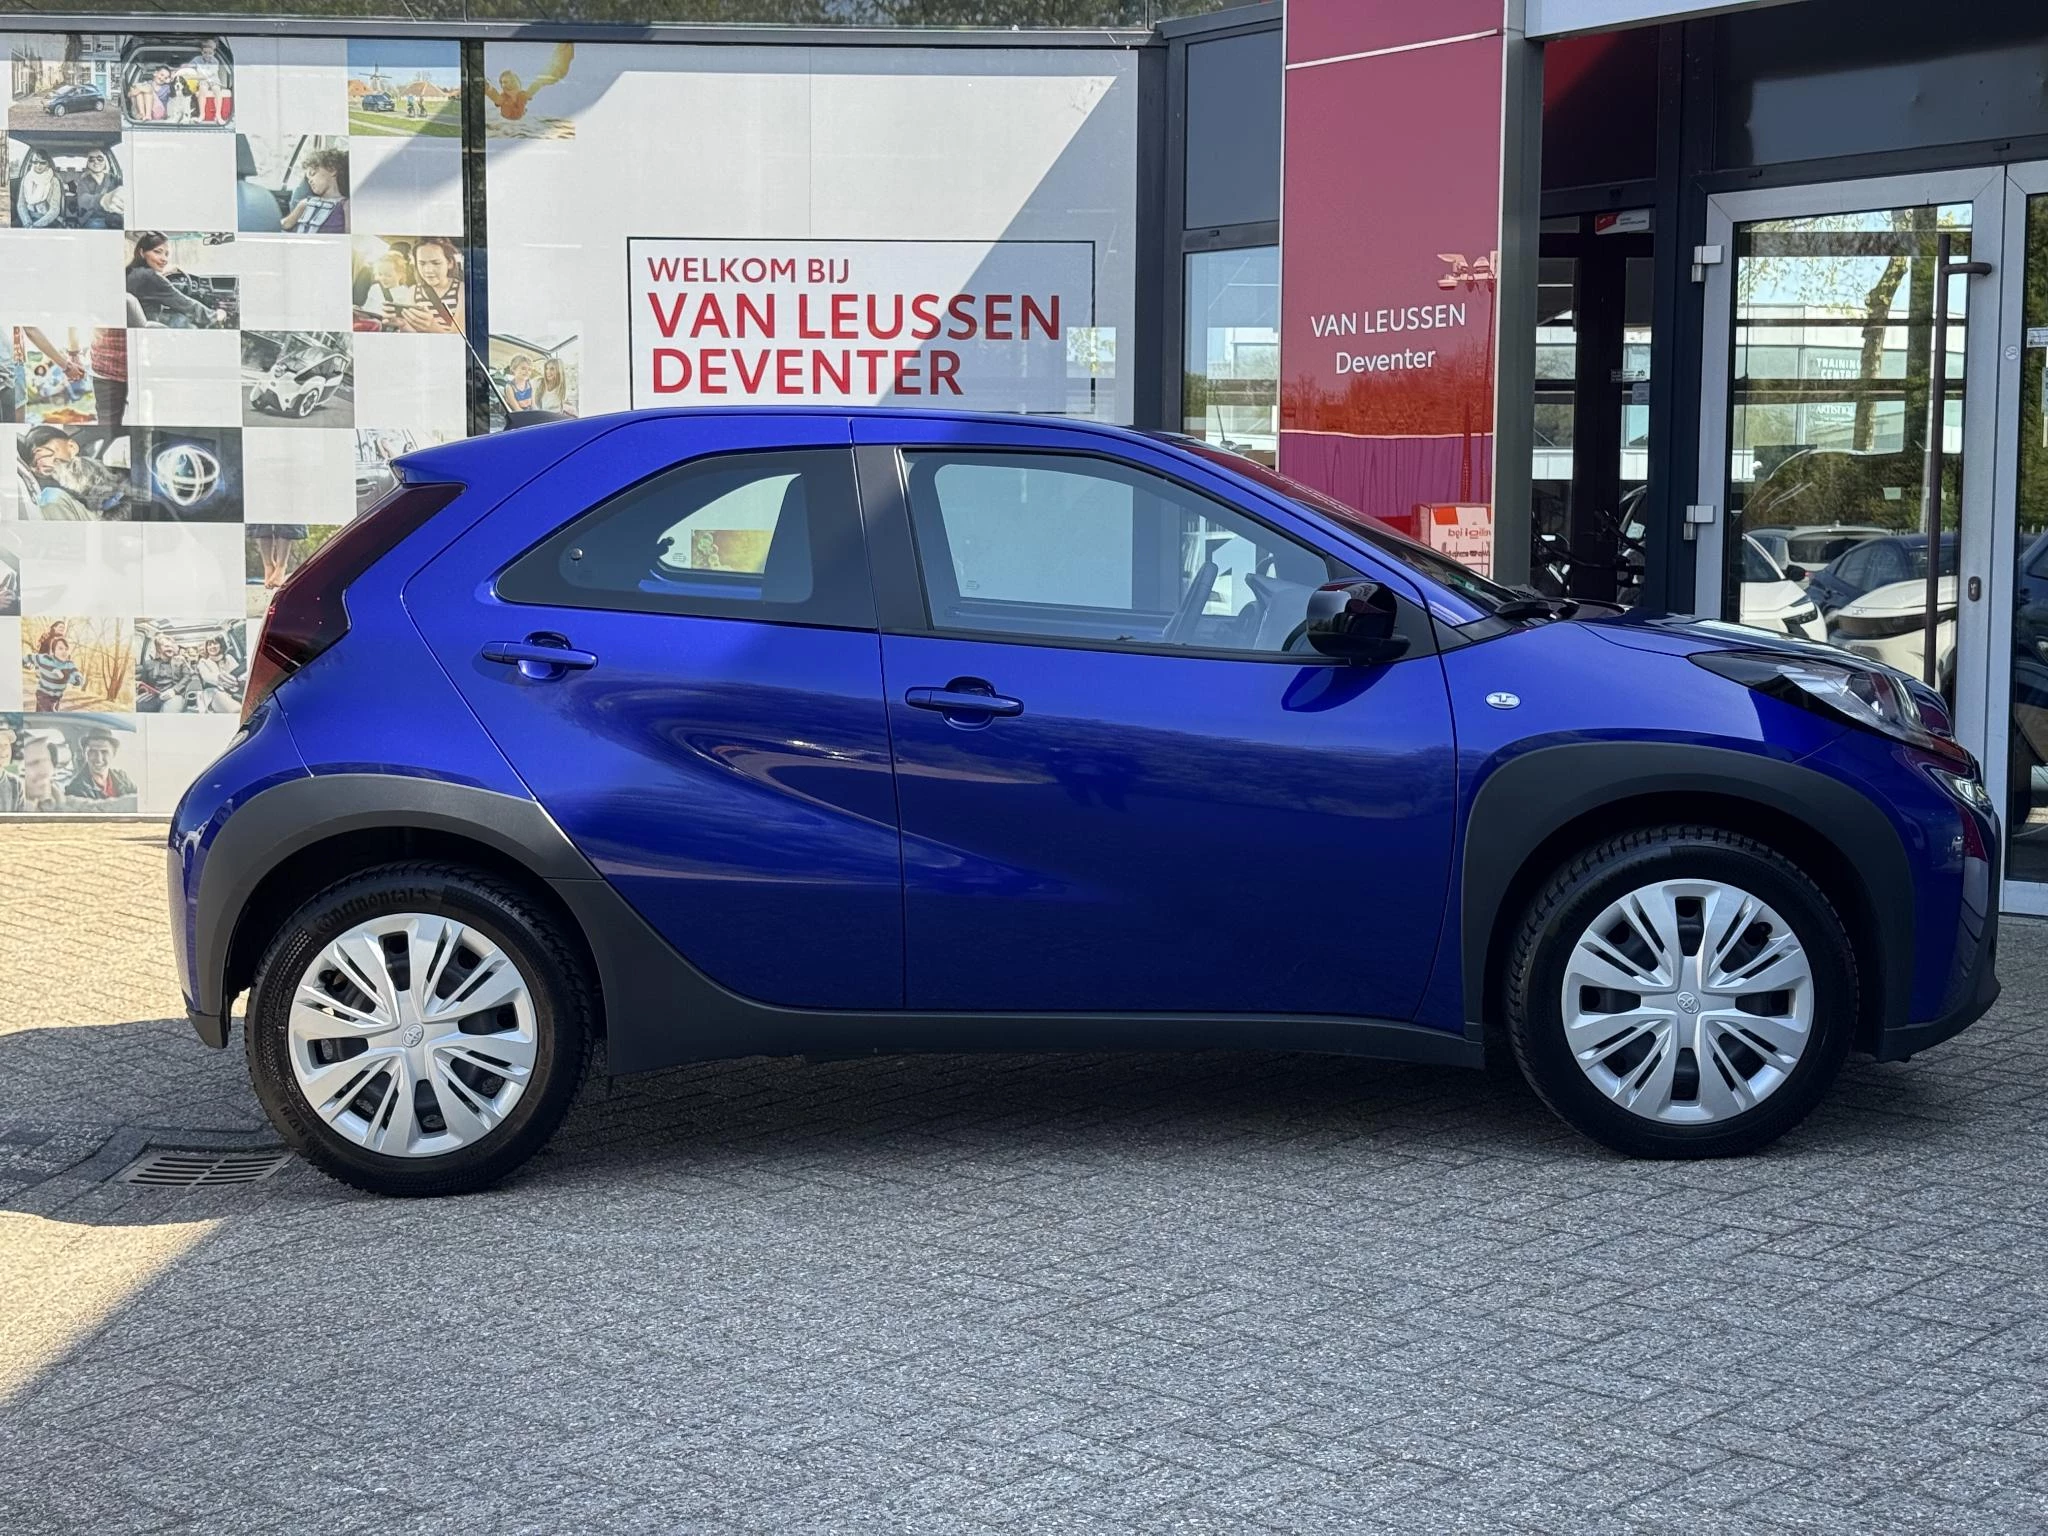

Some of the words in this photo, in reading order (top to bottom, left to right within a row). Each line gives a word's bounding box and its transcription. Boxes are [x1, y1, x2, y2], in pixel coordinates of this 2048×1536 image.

[647, 257, 796, 283] WELKOM
[807, 258, 849, 284] BIJ
[647, 292, 776, 339] VAN
[798, 293, 1060, 341] LEUSSEN
[1310, 312, 1357, 338] VAN
[1364, 302, 1466, 334] LEUSSEN
[652, 348, 965, 396] DEVENTER
[1335, 348, 1437, 375] Deventer
[1820, 368, 1858, 380] CENTRE
